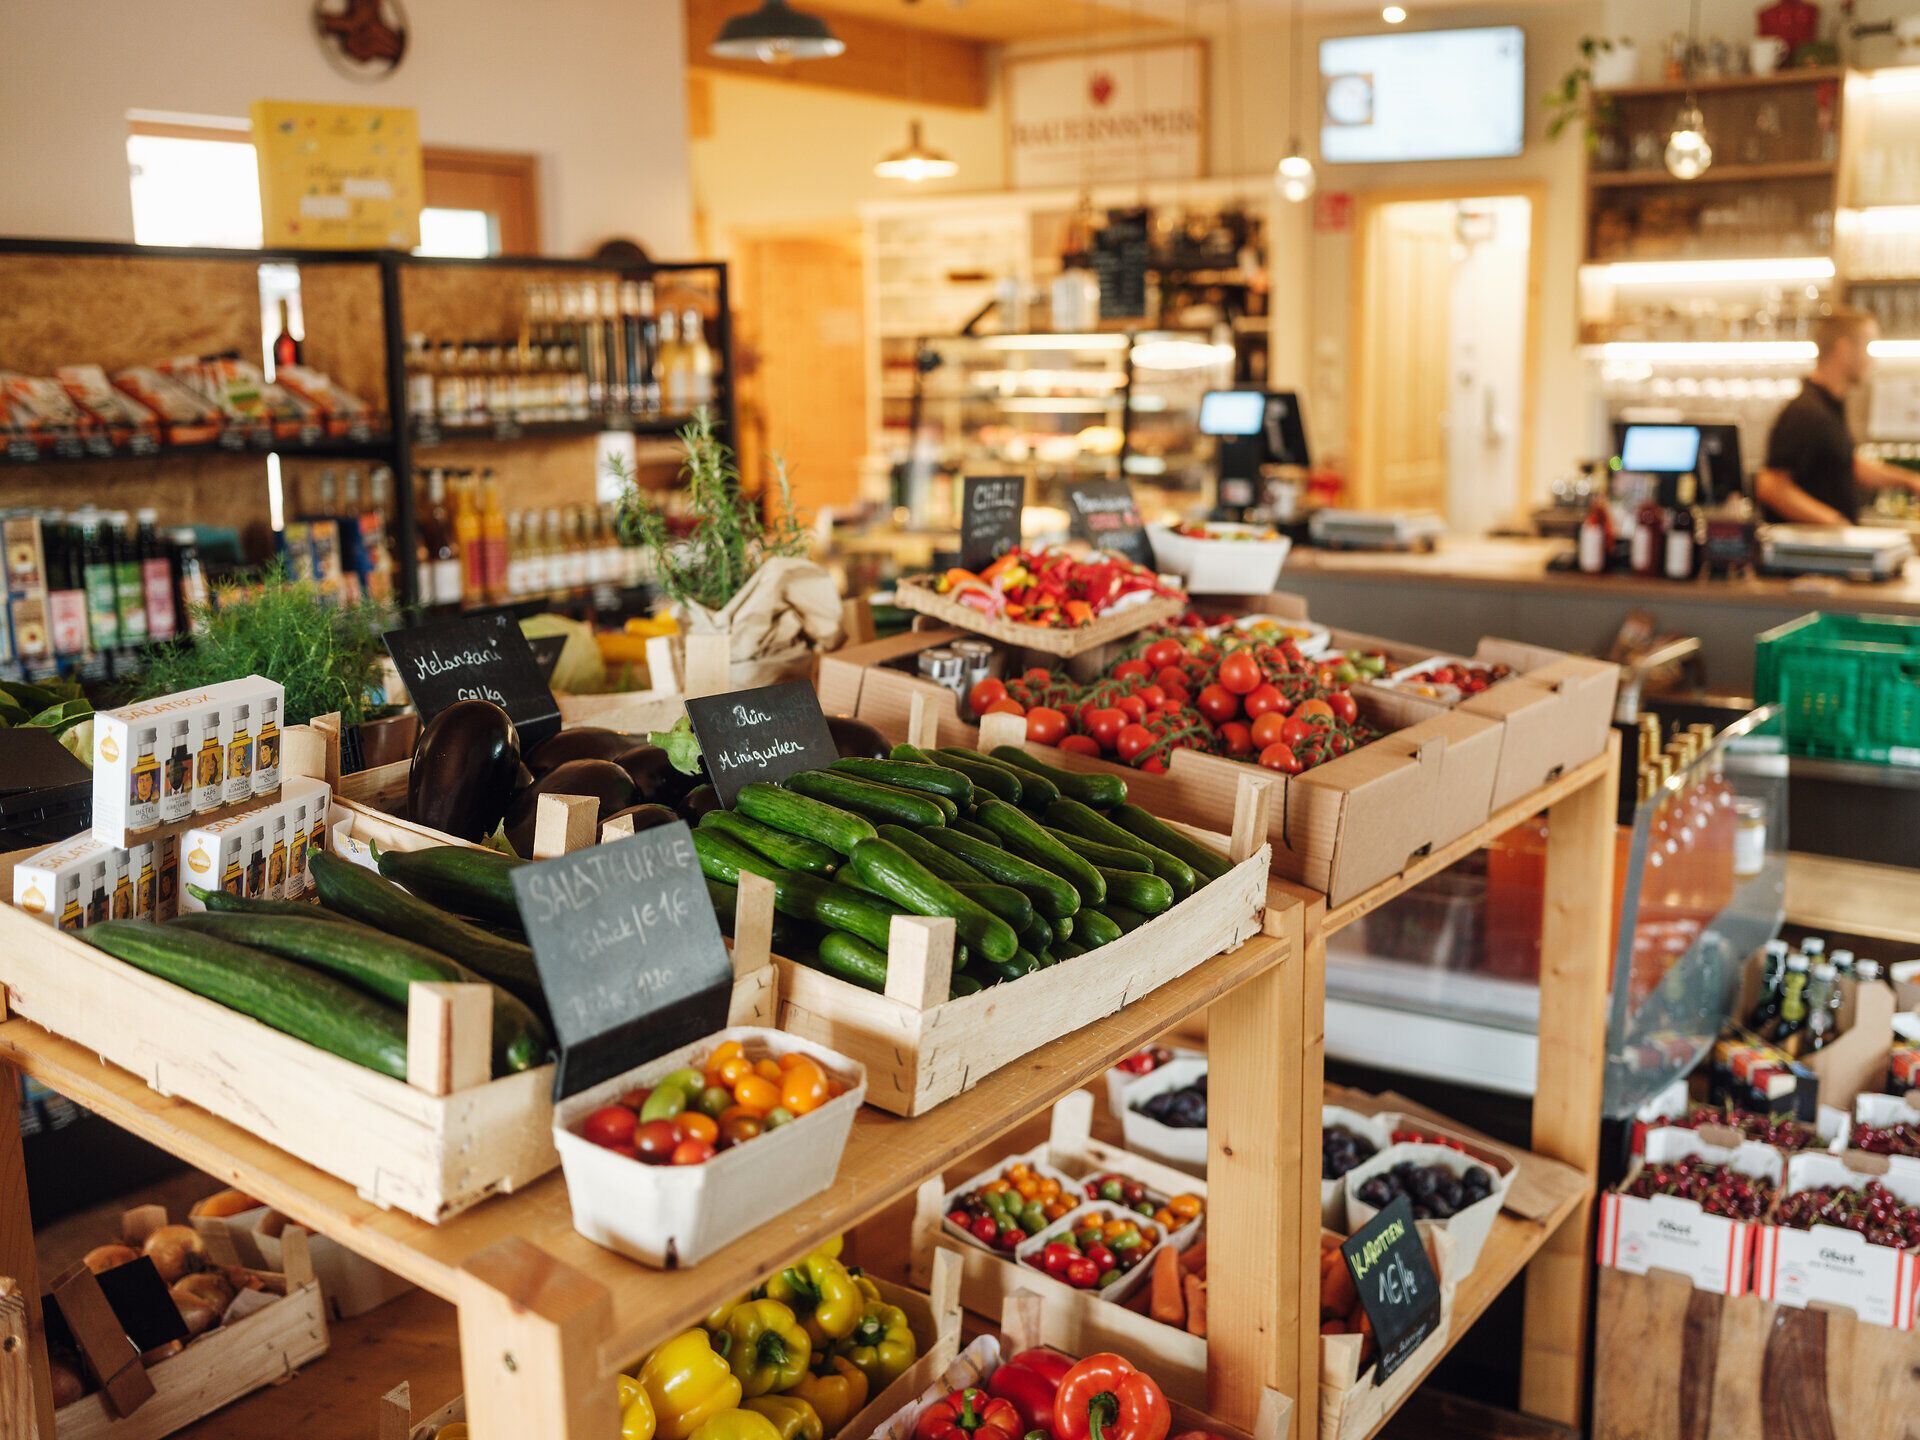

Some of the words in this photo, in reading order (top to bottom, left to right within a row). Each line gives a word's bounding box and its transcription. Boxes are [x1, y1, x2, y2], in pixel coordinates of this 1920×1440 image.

[414, 637, 502, 680] Melanzani
[117, 693, 212, 721] SALATBOX
[718, 738, 805, 772] Minigurken
[528, 839, 691, 922] SALATGURKE
[1350, 1218, 1405, 1280] KAROTTEN
